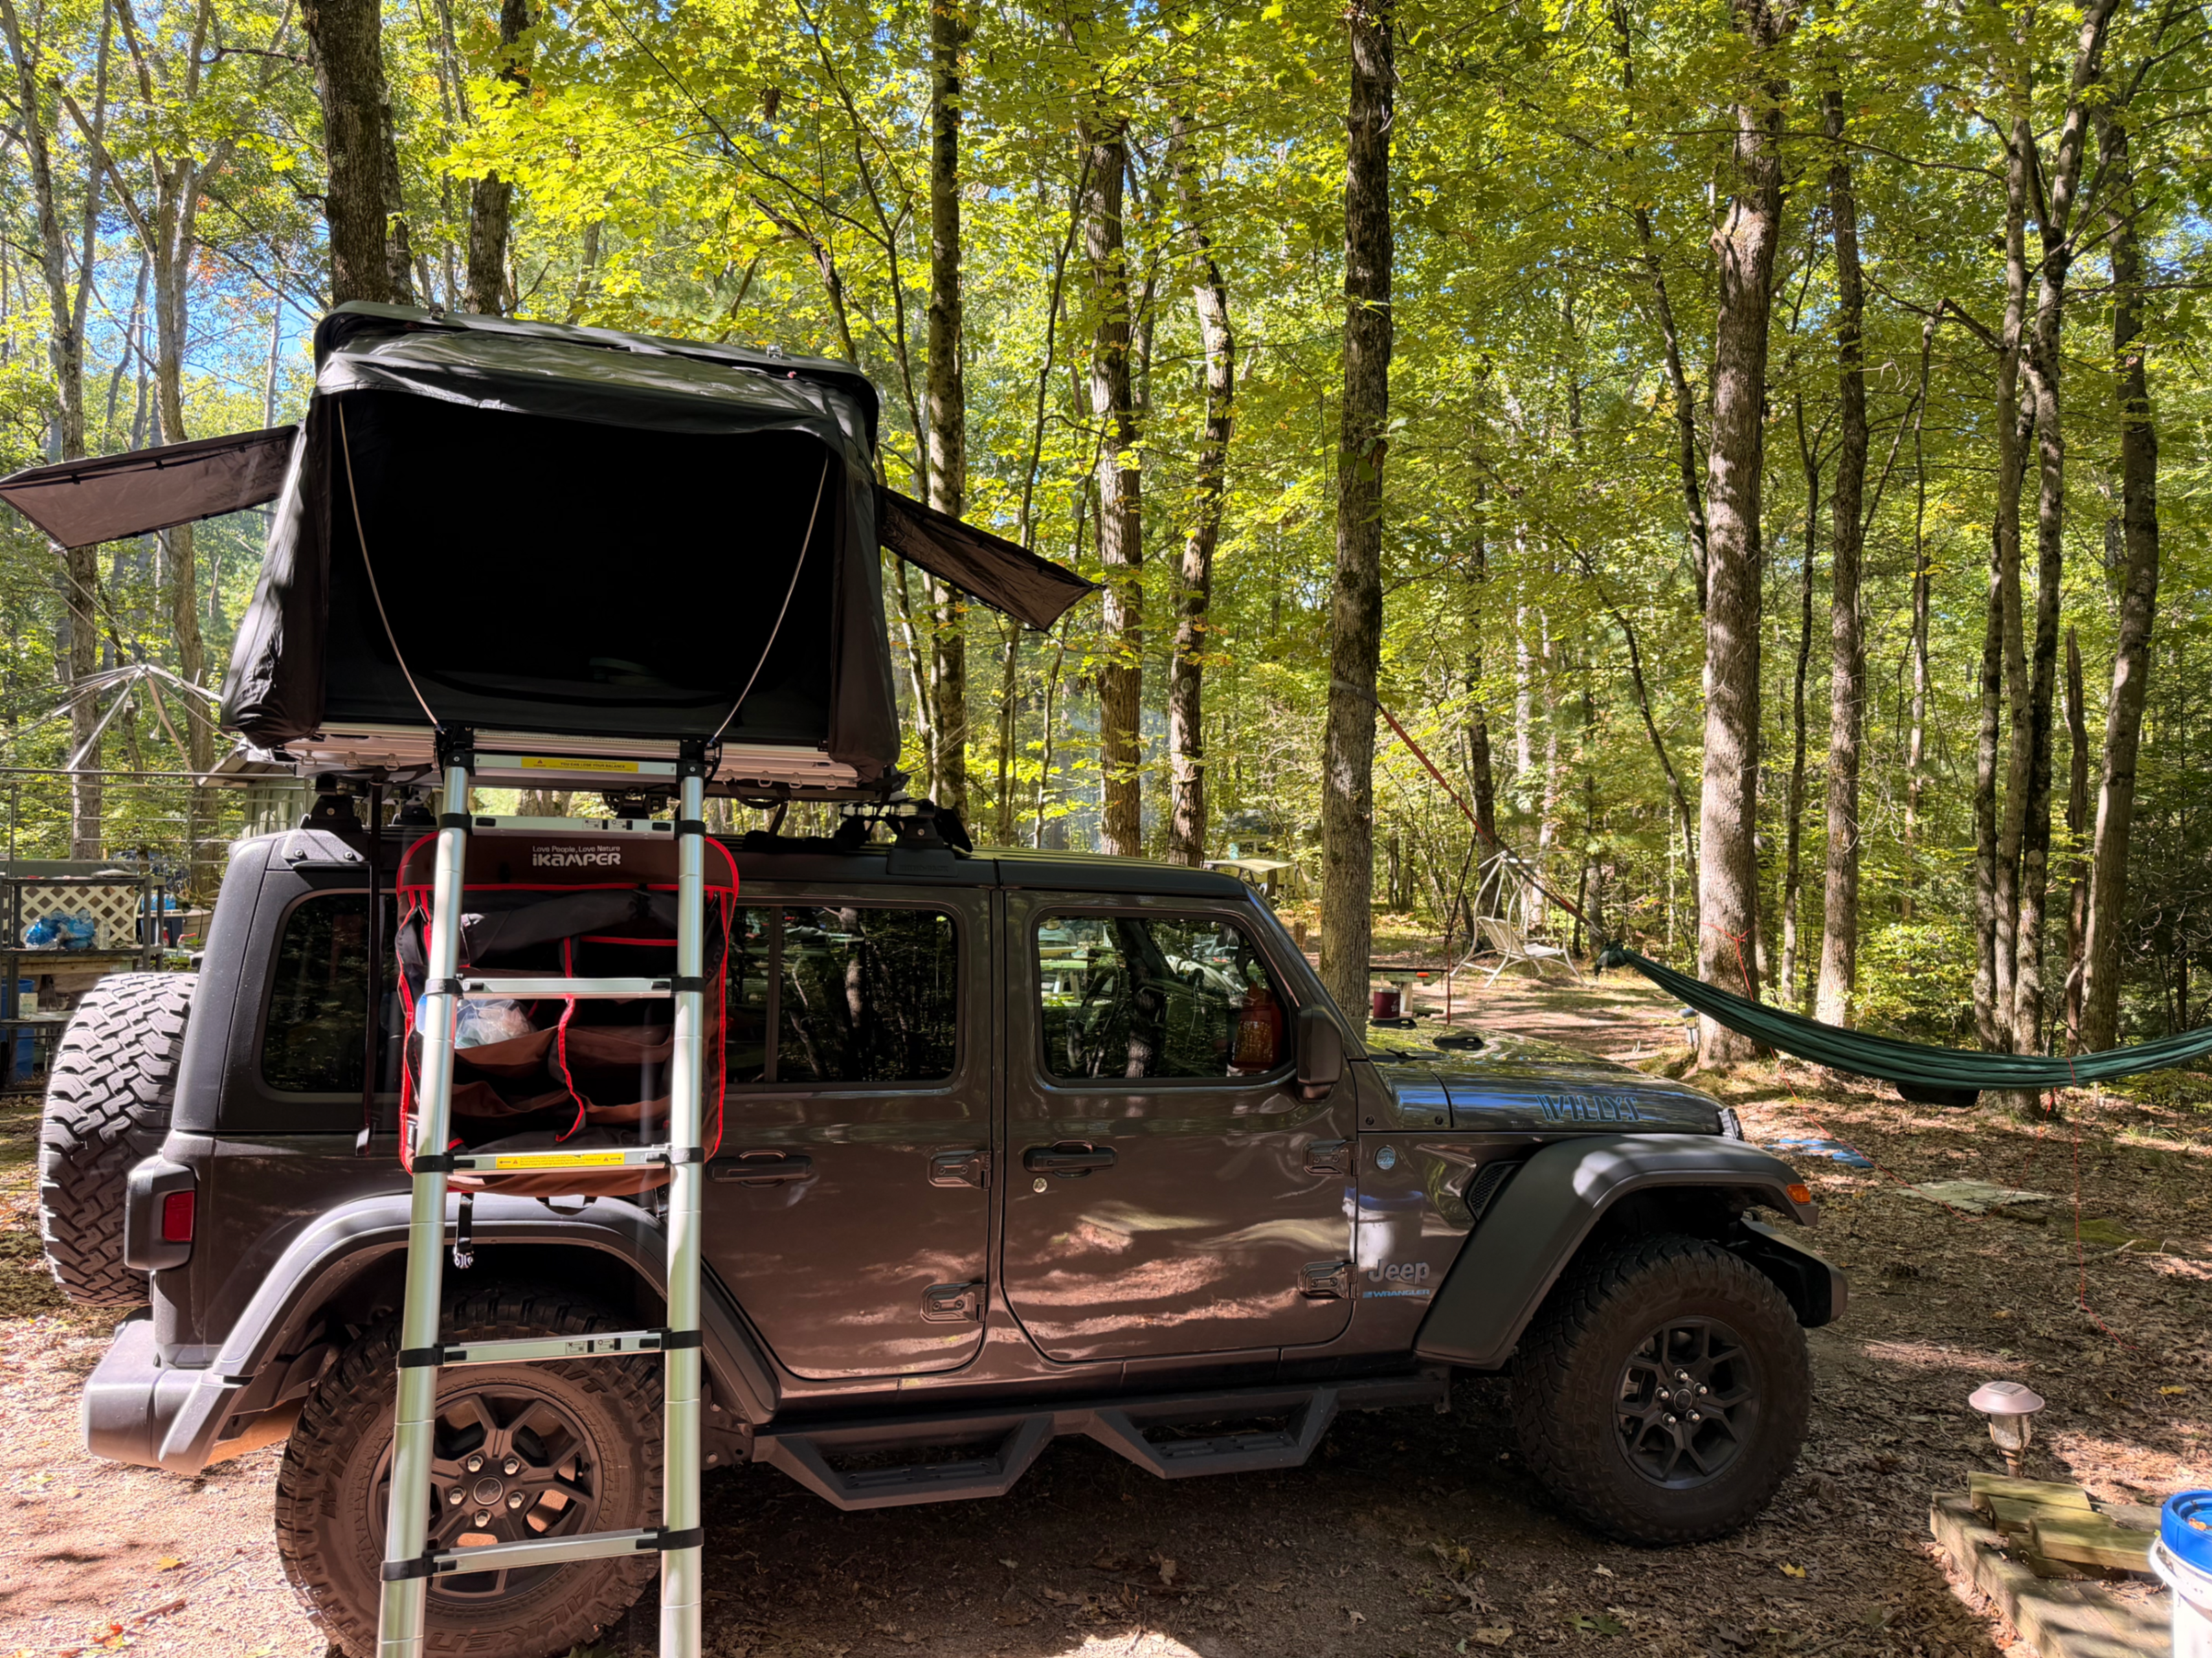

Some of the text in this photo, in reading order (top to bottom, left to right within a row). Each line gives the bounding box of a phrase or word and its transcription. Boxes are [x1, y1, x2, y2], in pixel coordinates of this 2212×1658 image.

[1536, 1093, 1641, 1122] WILLYS
[1368, 1259, 1430, 1284] Jeep
[1372, 1289, 1431, 1297] WRANGLER
[320, 1402, 381, 1519] WILD
[425, 1557, 614, 1653] FALKEN
